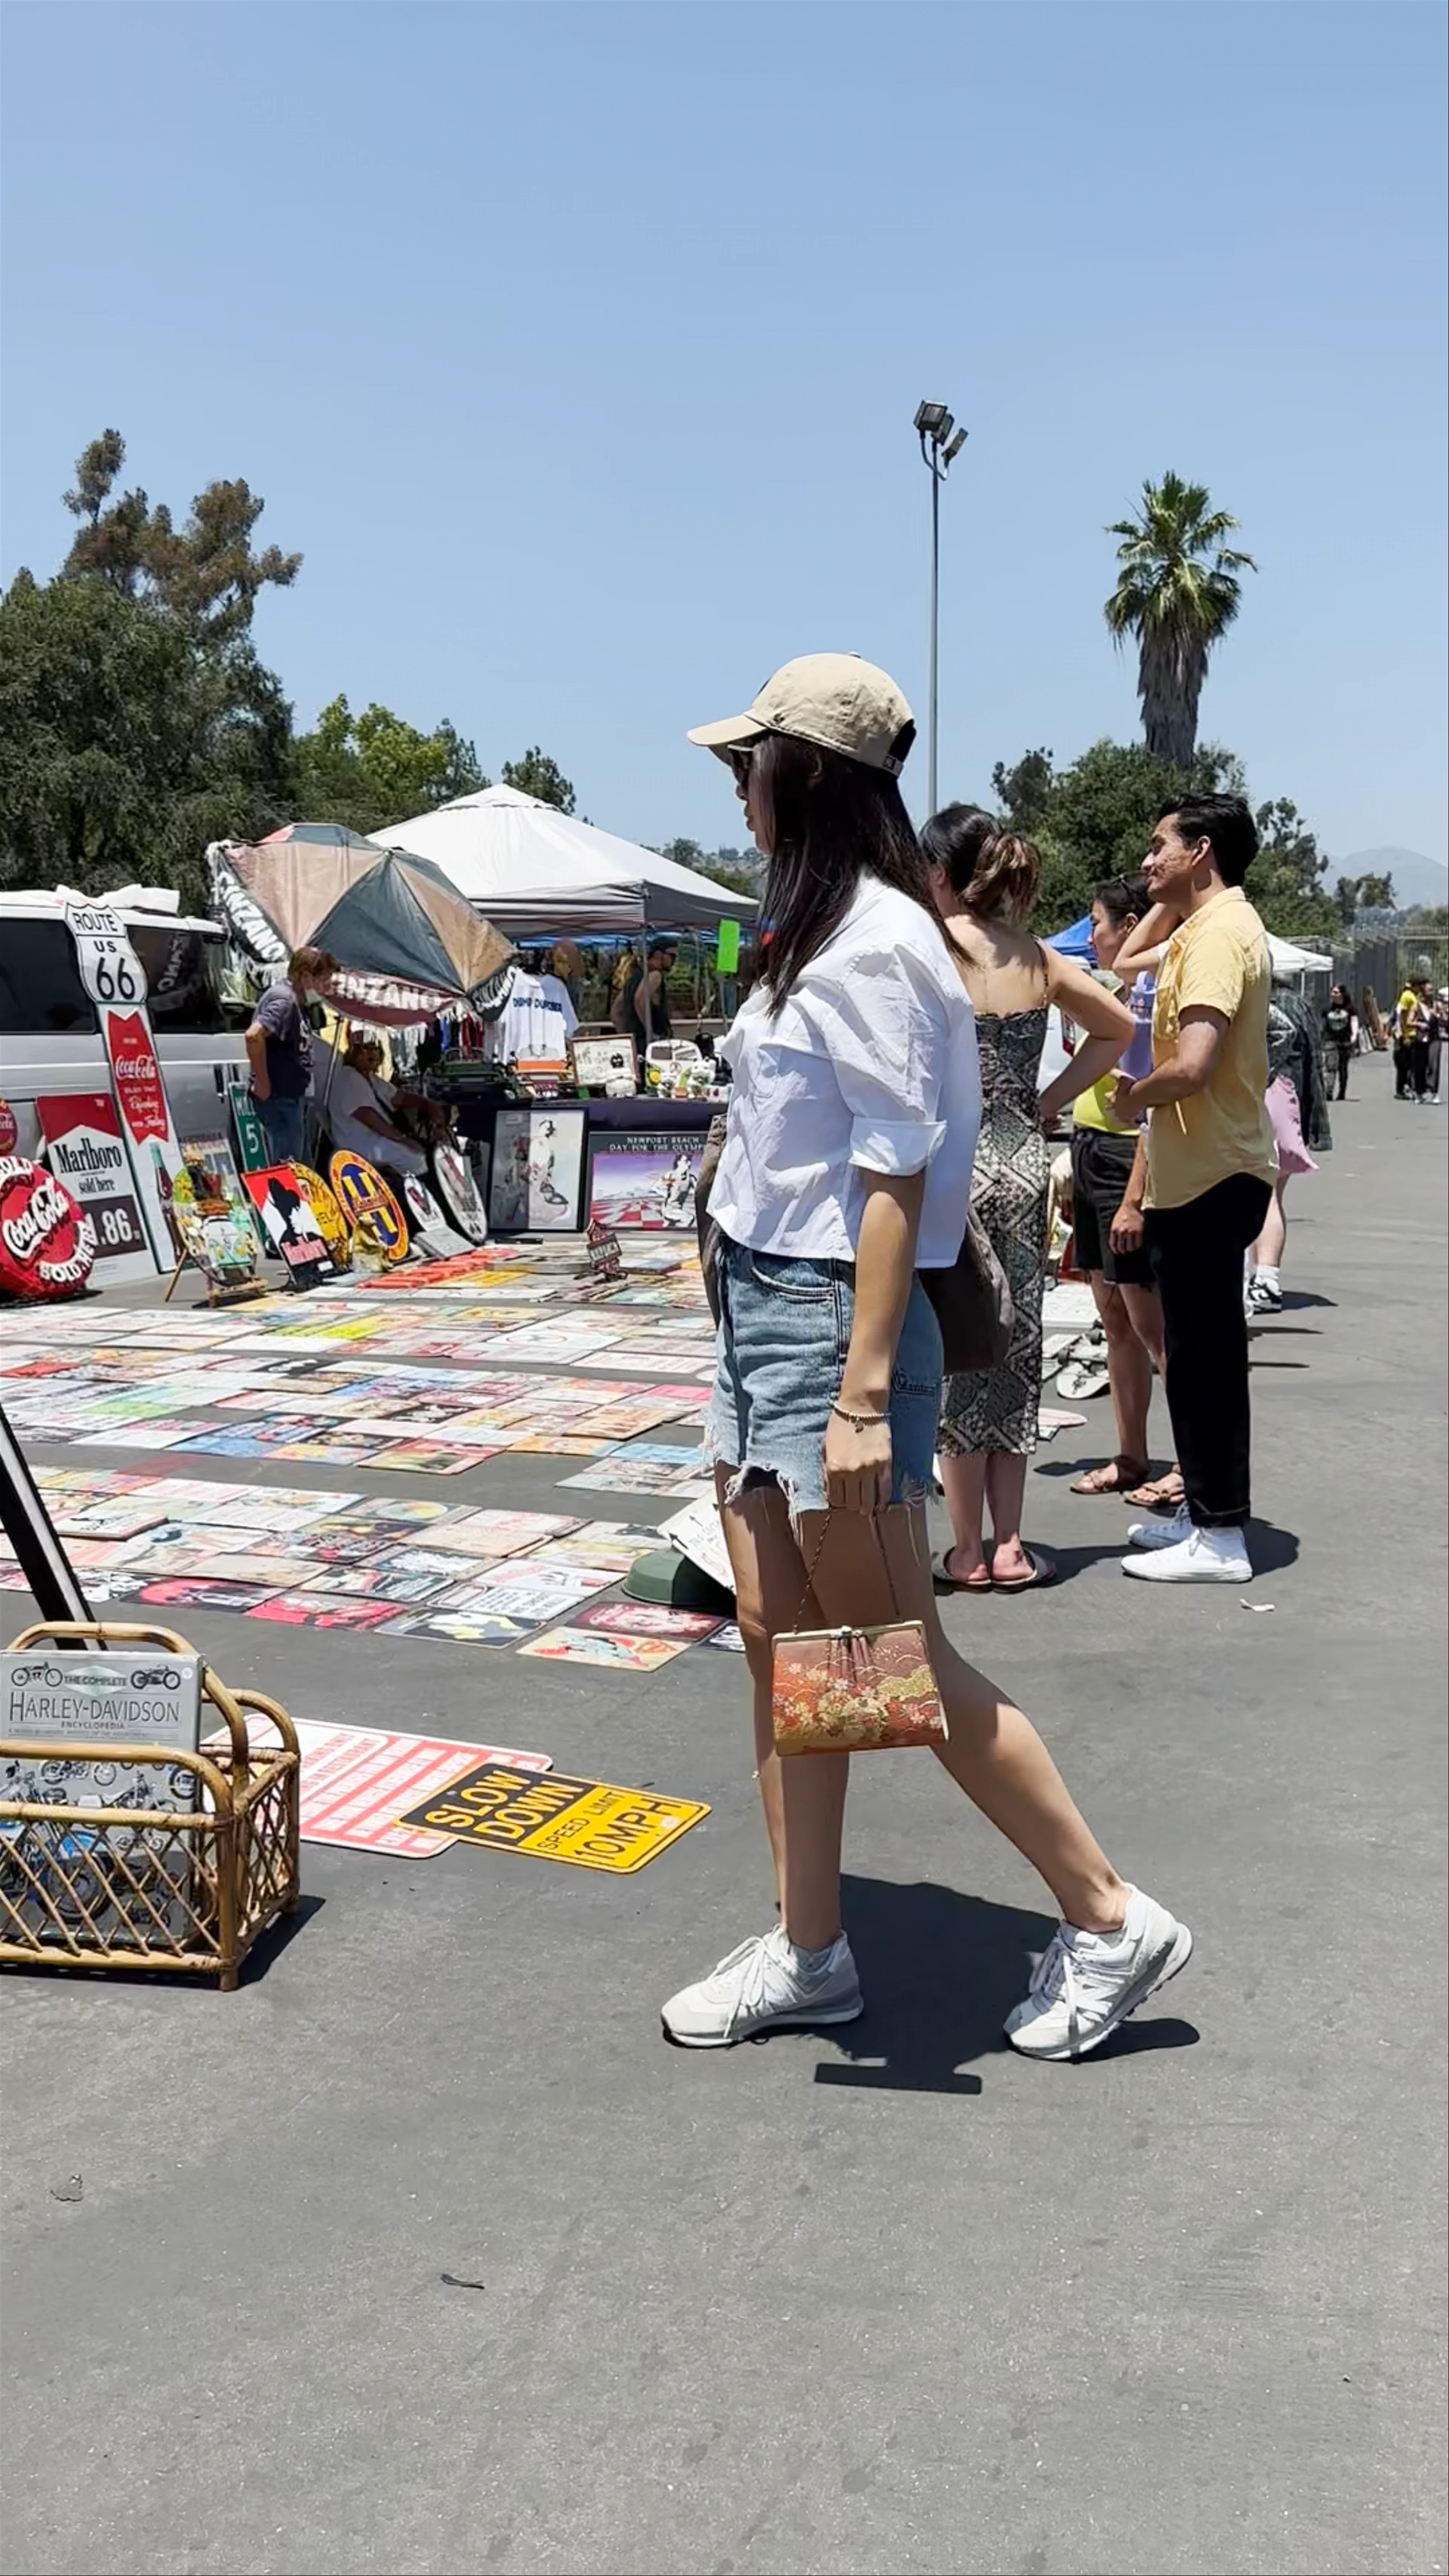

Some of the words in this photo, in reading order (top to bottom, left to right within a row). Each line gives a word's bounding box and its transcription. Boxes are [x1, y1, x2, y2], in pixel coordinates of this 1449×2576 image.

[72, 912, 118, 932] ROUTE
[93, 940, 117, 953] US
[96, 957, 135, 1000] 66
[331, 972, 442, 1013] INZANO
[246, 1123, 259, 1154] 5
[54, 1137, 122, 1174] Marlboro
[78, 1178, 96, 1195] sold
[95, 1176, 115, 1191] here
[64, 1675, 80, 1684] THE
[82, 1675, 127, 1686] COMPLETE
[10, 1691, 180, 1722] HARLEY-DAVIDSON
[61, 1721, 125, 1729] ENCYCLOPEDIA
[425, 1770, 531, 1828] SLOW
[473, 1780, 585, 1839] DOWN
[537, 1817, 590, 1849] SPEED
[583, 1792, 626, 1816] LIMIT
